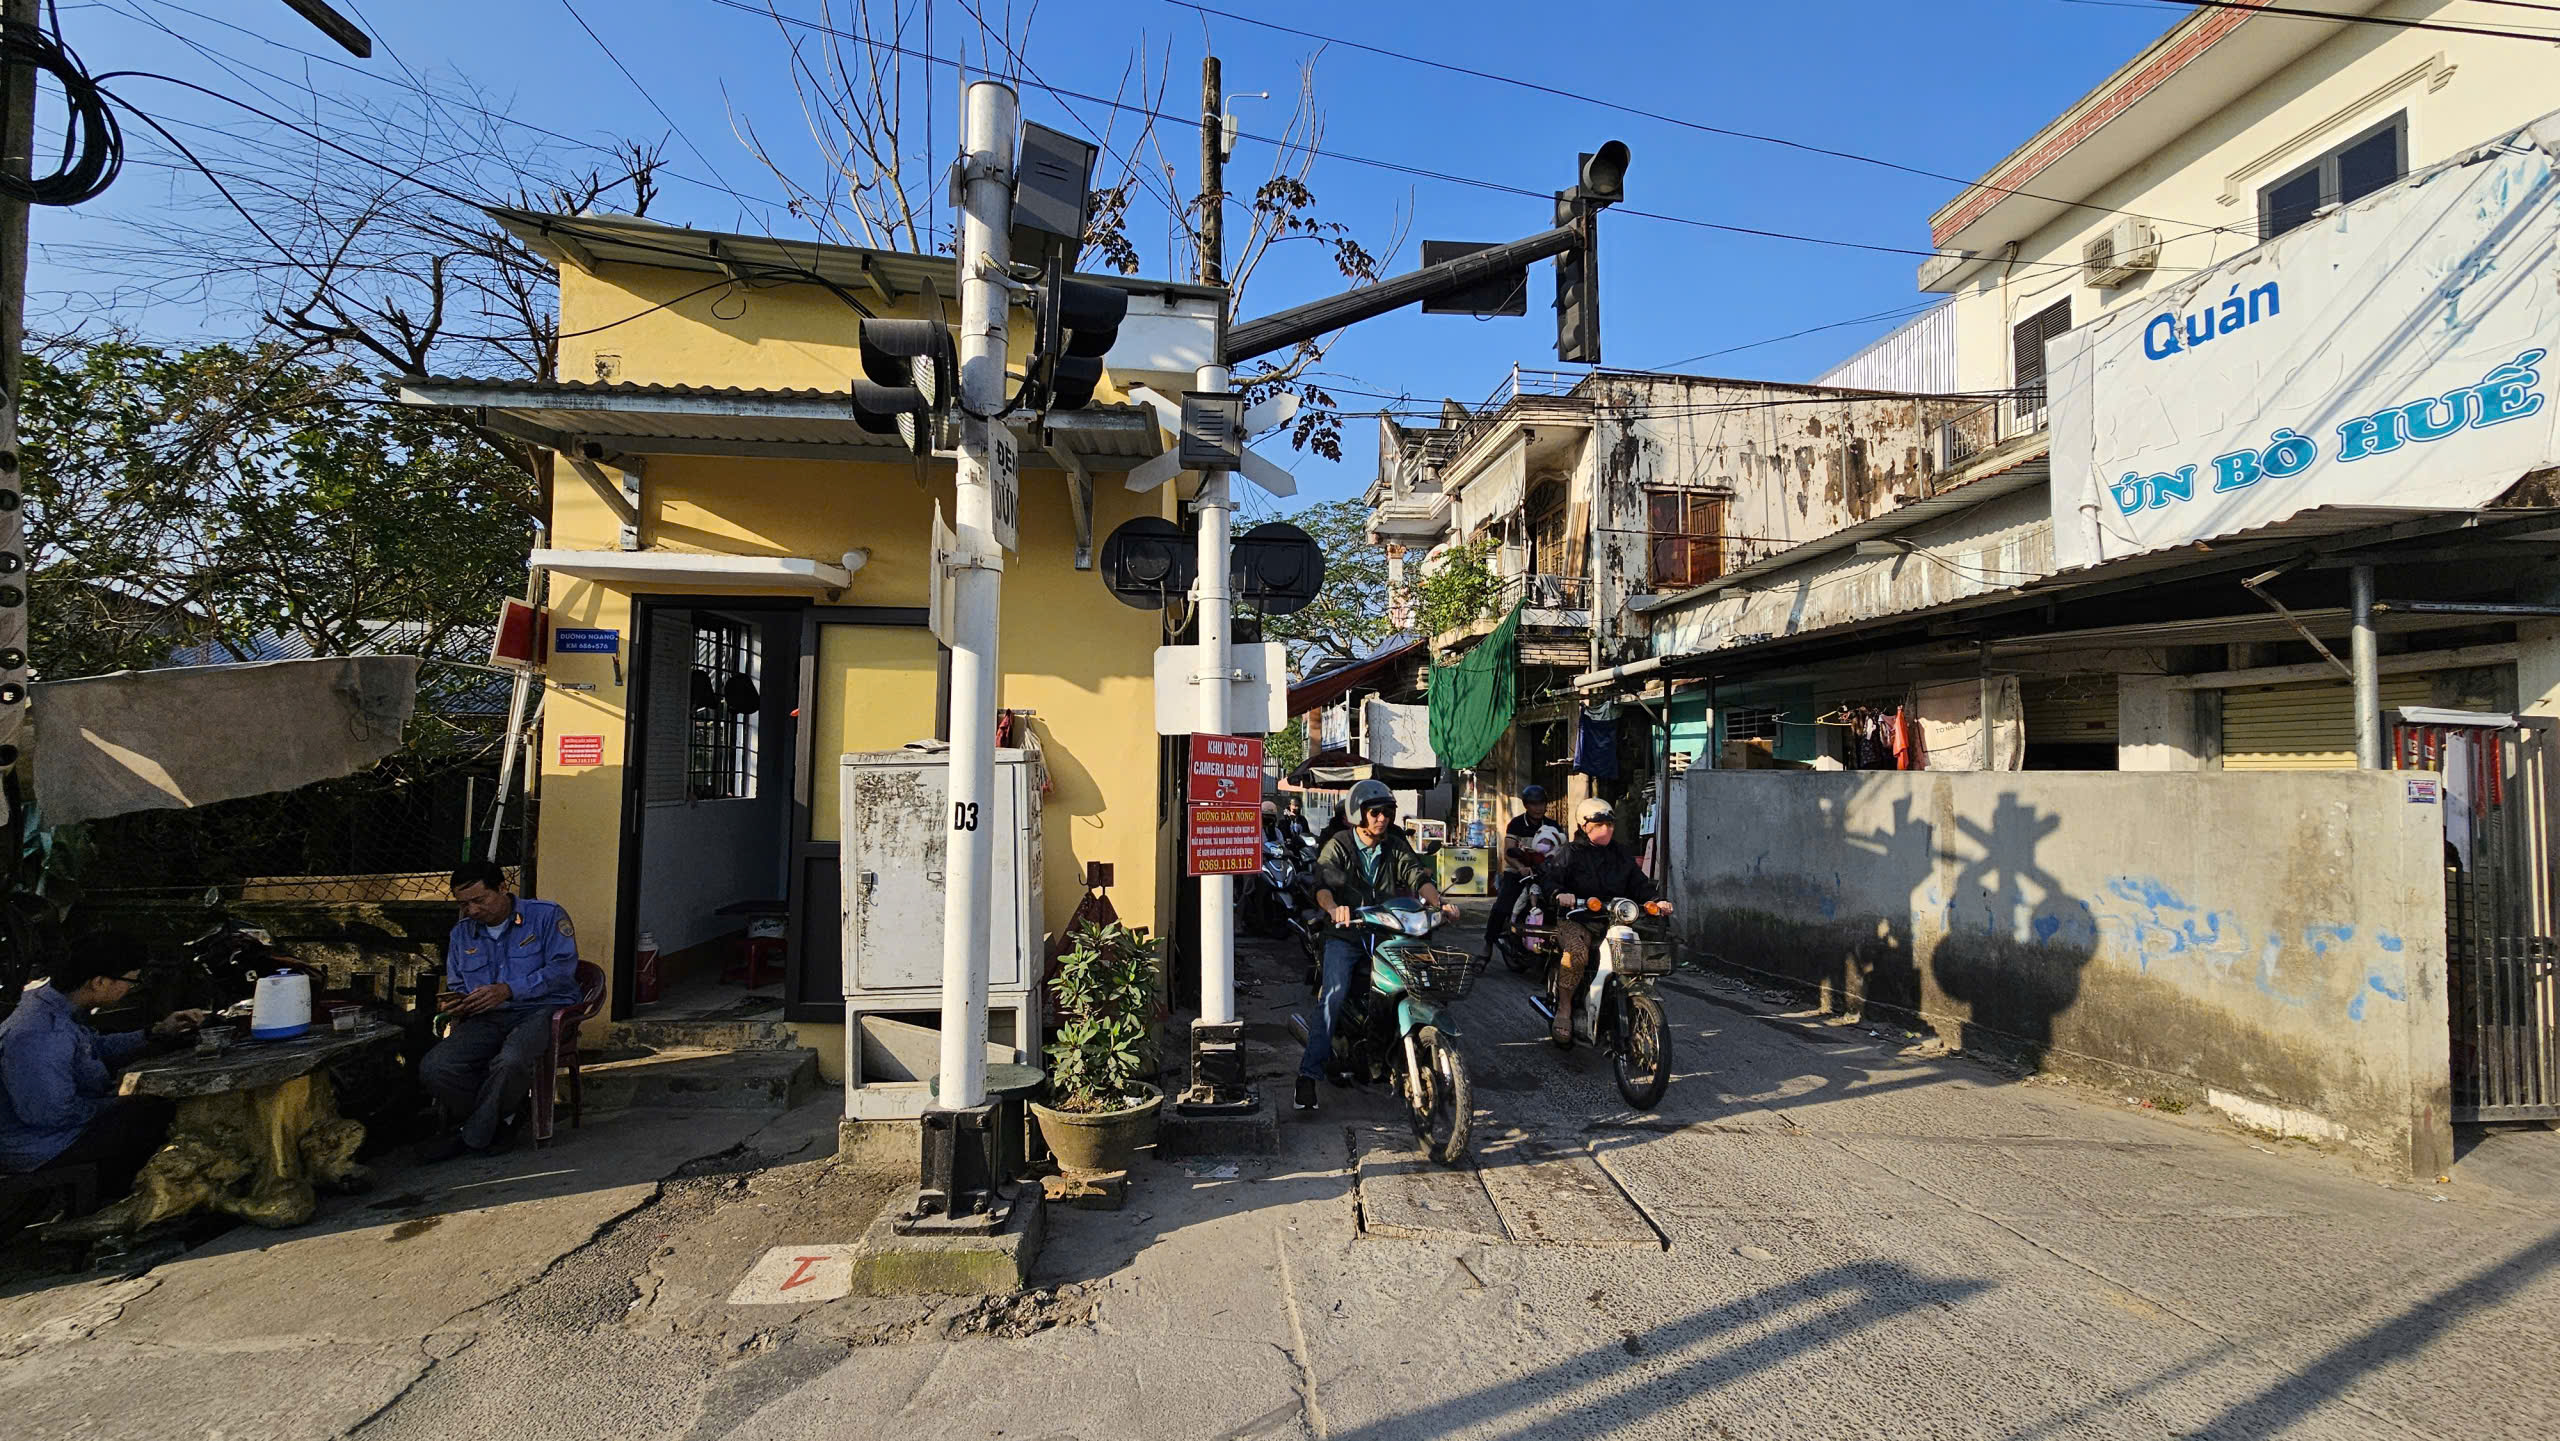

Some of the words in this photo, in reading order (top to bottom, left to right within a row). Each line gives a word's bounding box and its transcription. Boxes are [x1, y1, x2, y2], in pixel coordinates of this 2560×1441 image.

[2143, 280, 2281, 361] Quán
[2109, 463, 2198, 517] ÚN
[2211, 428, 2318, 494] BÒ
[2336, 348, 2548, 463] HUẾ
[995, 439, 1018, 479] ĐÈN
[994, 477, 1019, 533] DỪN
[588, 633, 616, 641] NGANG
[1207, 740, 1223, 755] KHU
[1224, 742, 1237, 758] VỰC
[1238, 742, 1249, 757] CÓ
[1193, 761, 1225, 776] CAMERA
[1226, 762, 1245, 778] GIÁM
[1246, 763, 1259, 779] SÁT
[953, 802, 979, 832] D3
[1196, 809, 1219, 821] ĐƯỜNG
[1221, 809, 1234, 821] DÂY
[1199, 857, 1253, 871] 0369.118.118
